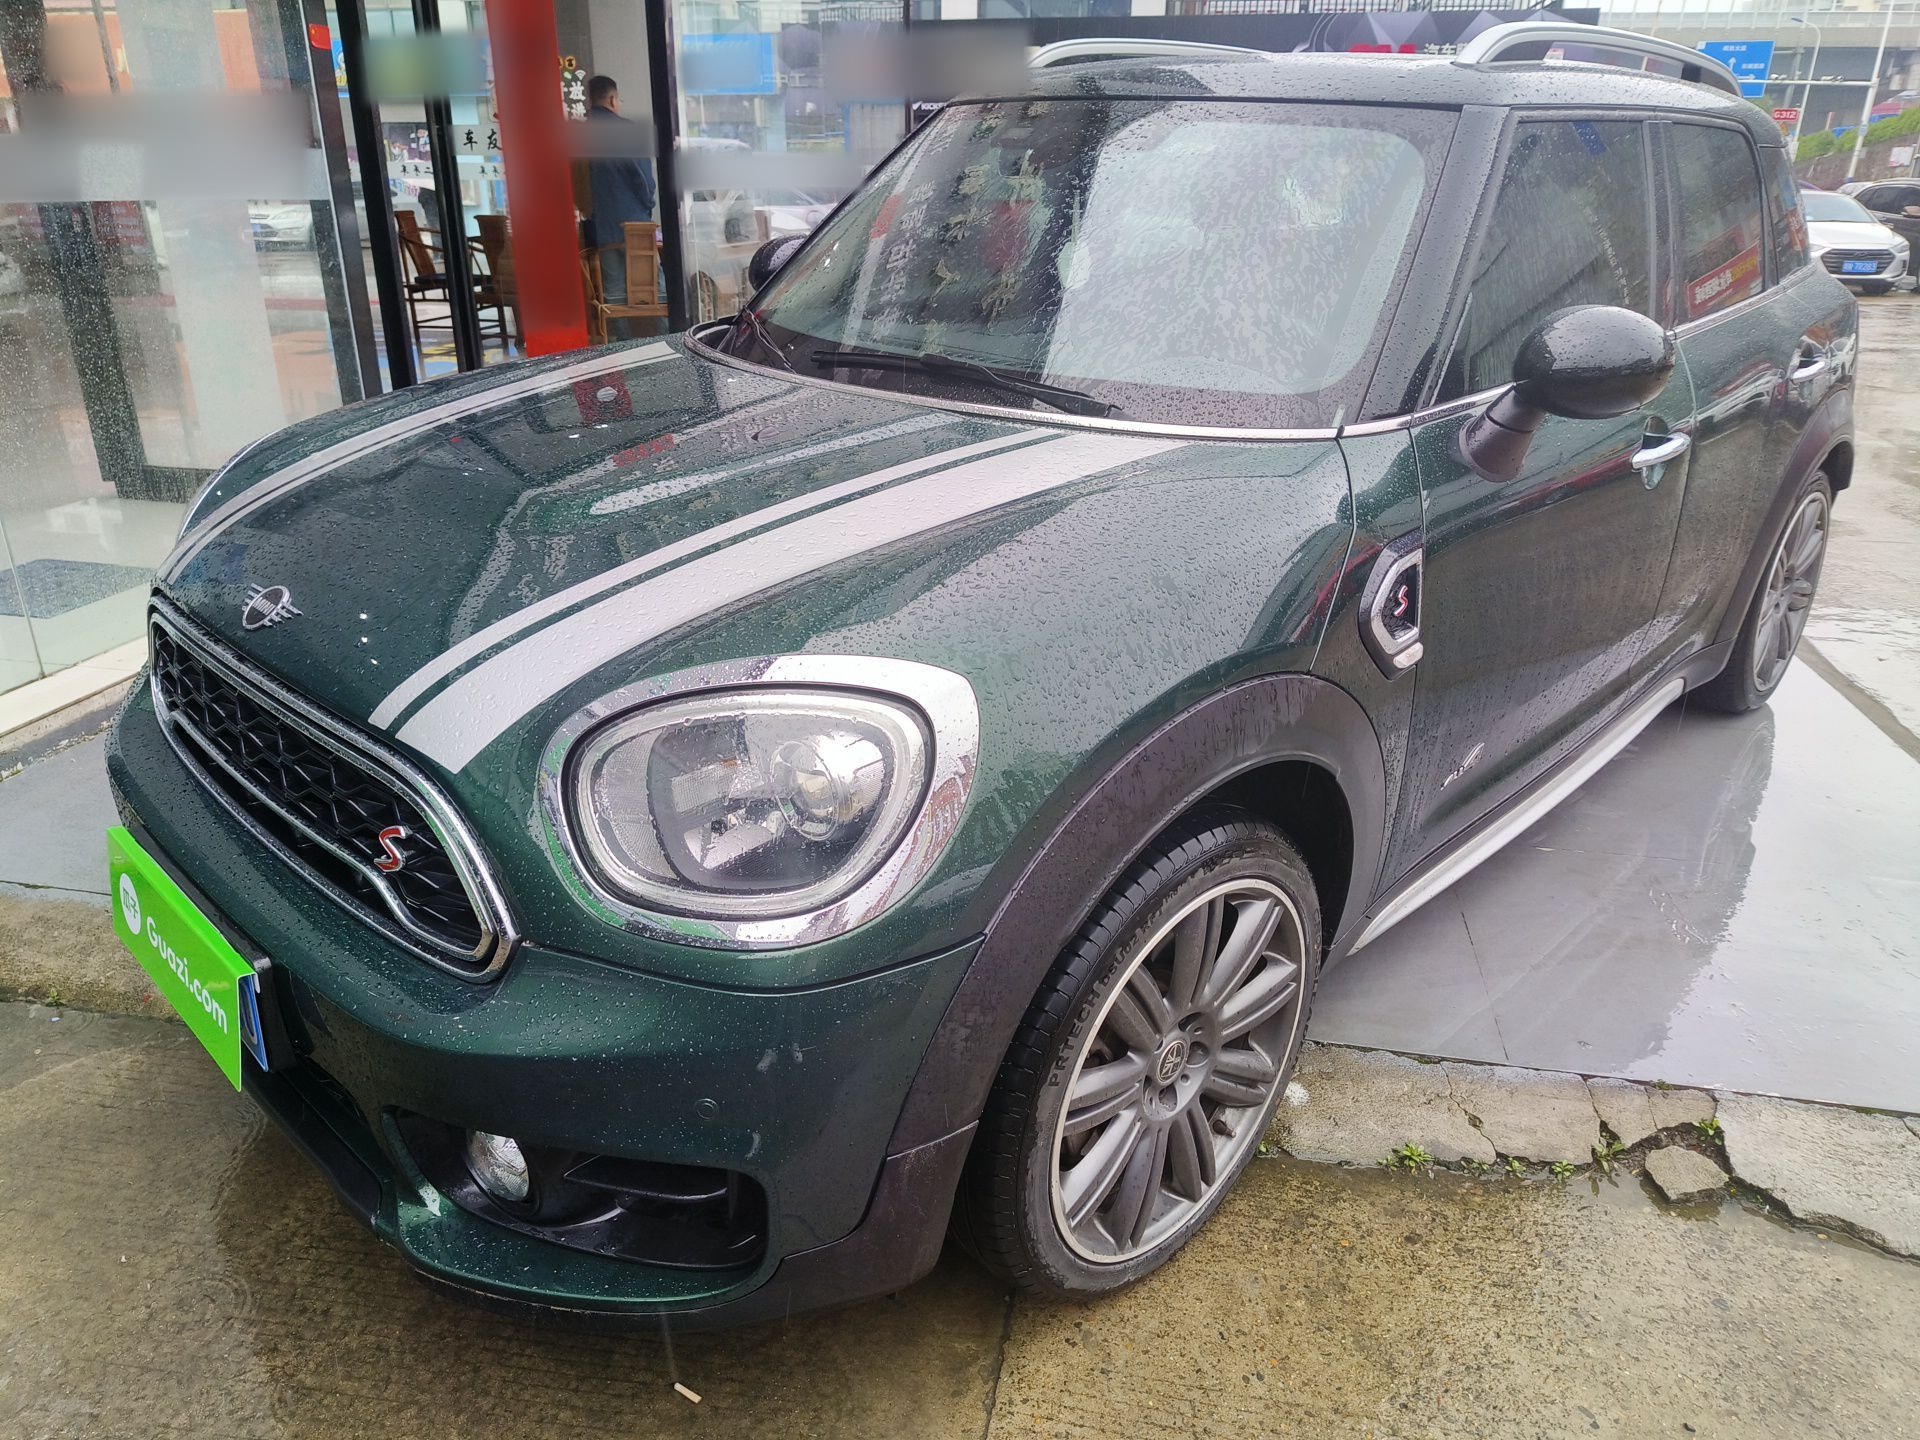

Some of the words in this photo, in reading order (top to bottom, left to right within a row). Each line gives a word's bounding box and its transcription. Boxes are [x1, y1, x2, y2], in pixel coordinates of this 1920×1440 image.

[1774, 111, 1797, 119] G312
[252, 597, 277, 616] MINI
[1393, 585, 1409, 617] S
[373, 825, 406, 873] S
[122, 886, 139, 920] 瓜子
[146, 916, 228, 1035] Guazi.com
